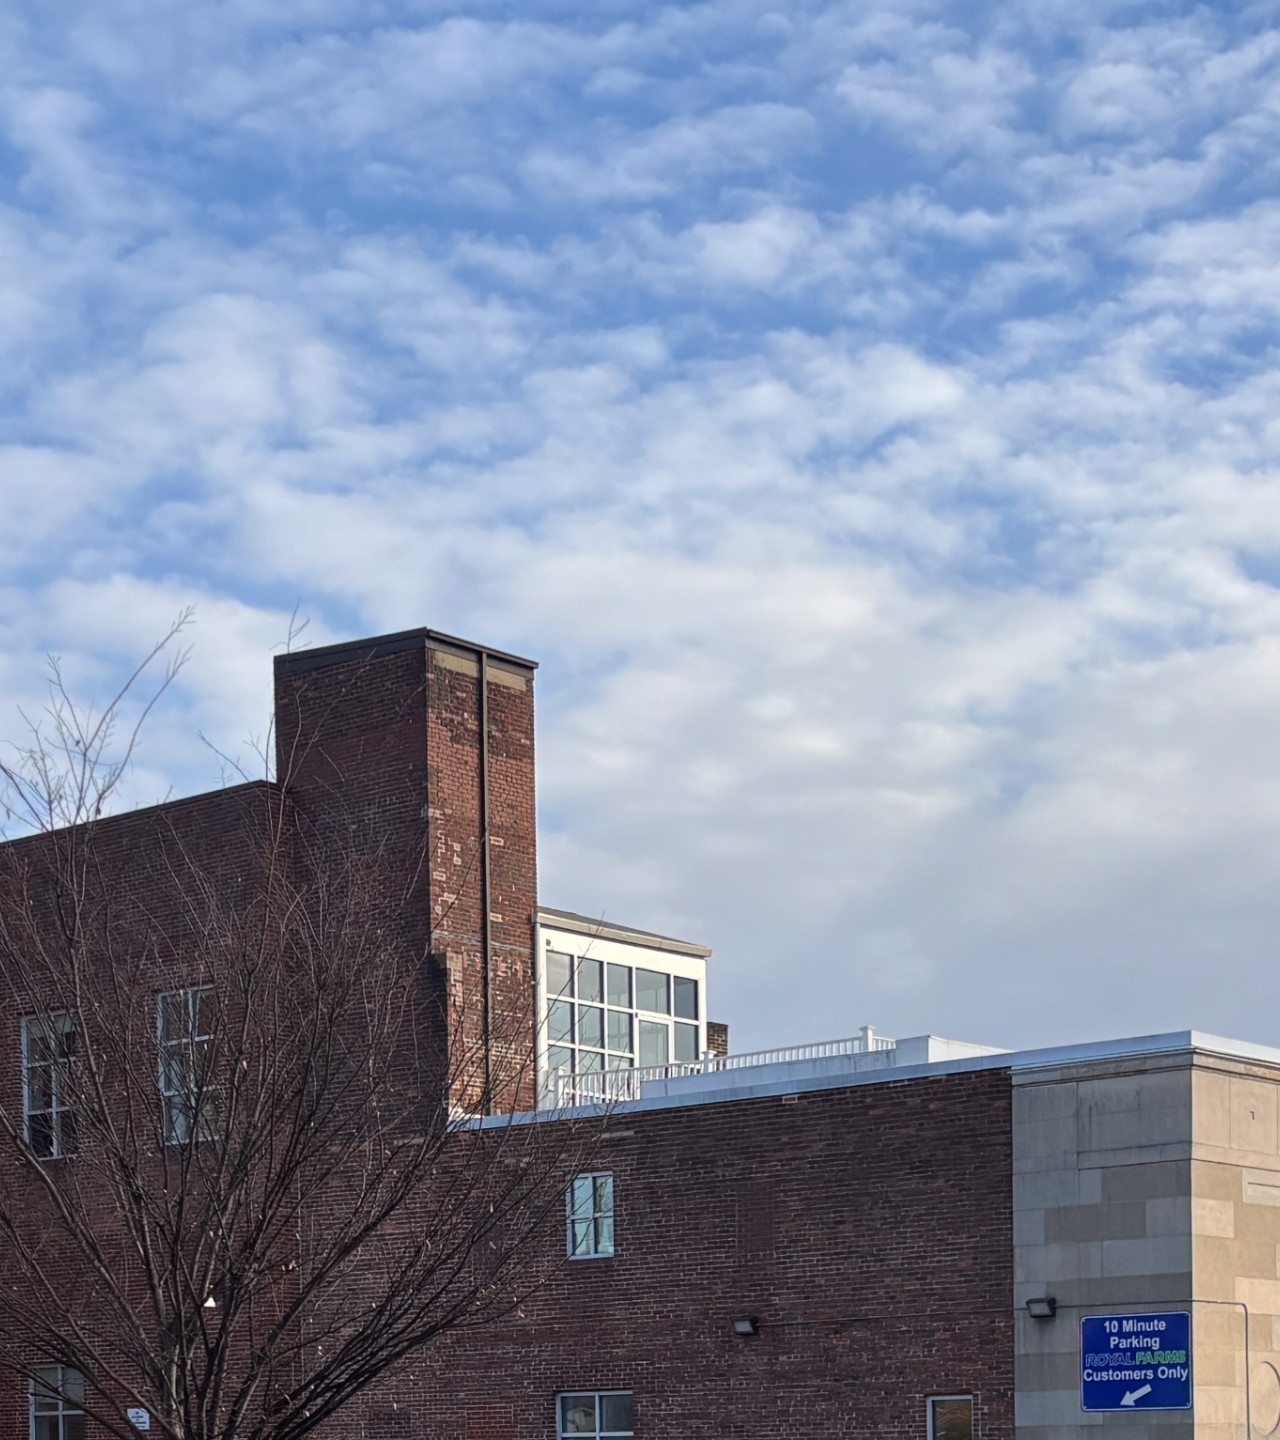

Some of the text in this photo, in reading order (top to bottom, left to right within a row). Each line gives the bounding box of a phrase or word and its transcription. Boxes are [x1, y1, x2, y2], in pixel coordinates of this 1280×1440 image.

[1103, 1319, 1166, 1333] 10 Minute
[1110, 1335, 1160, 1350] Parking
[1085, 1350, 1187, 1367] ROYAL FARMS
[1083, 1366, 1188, 1381] Customers Only
